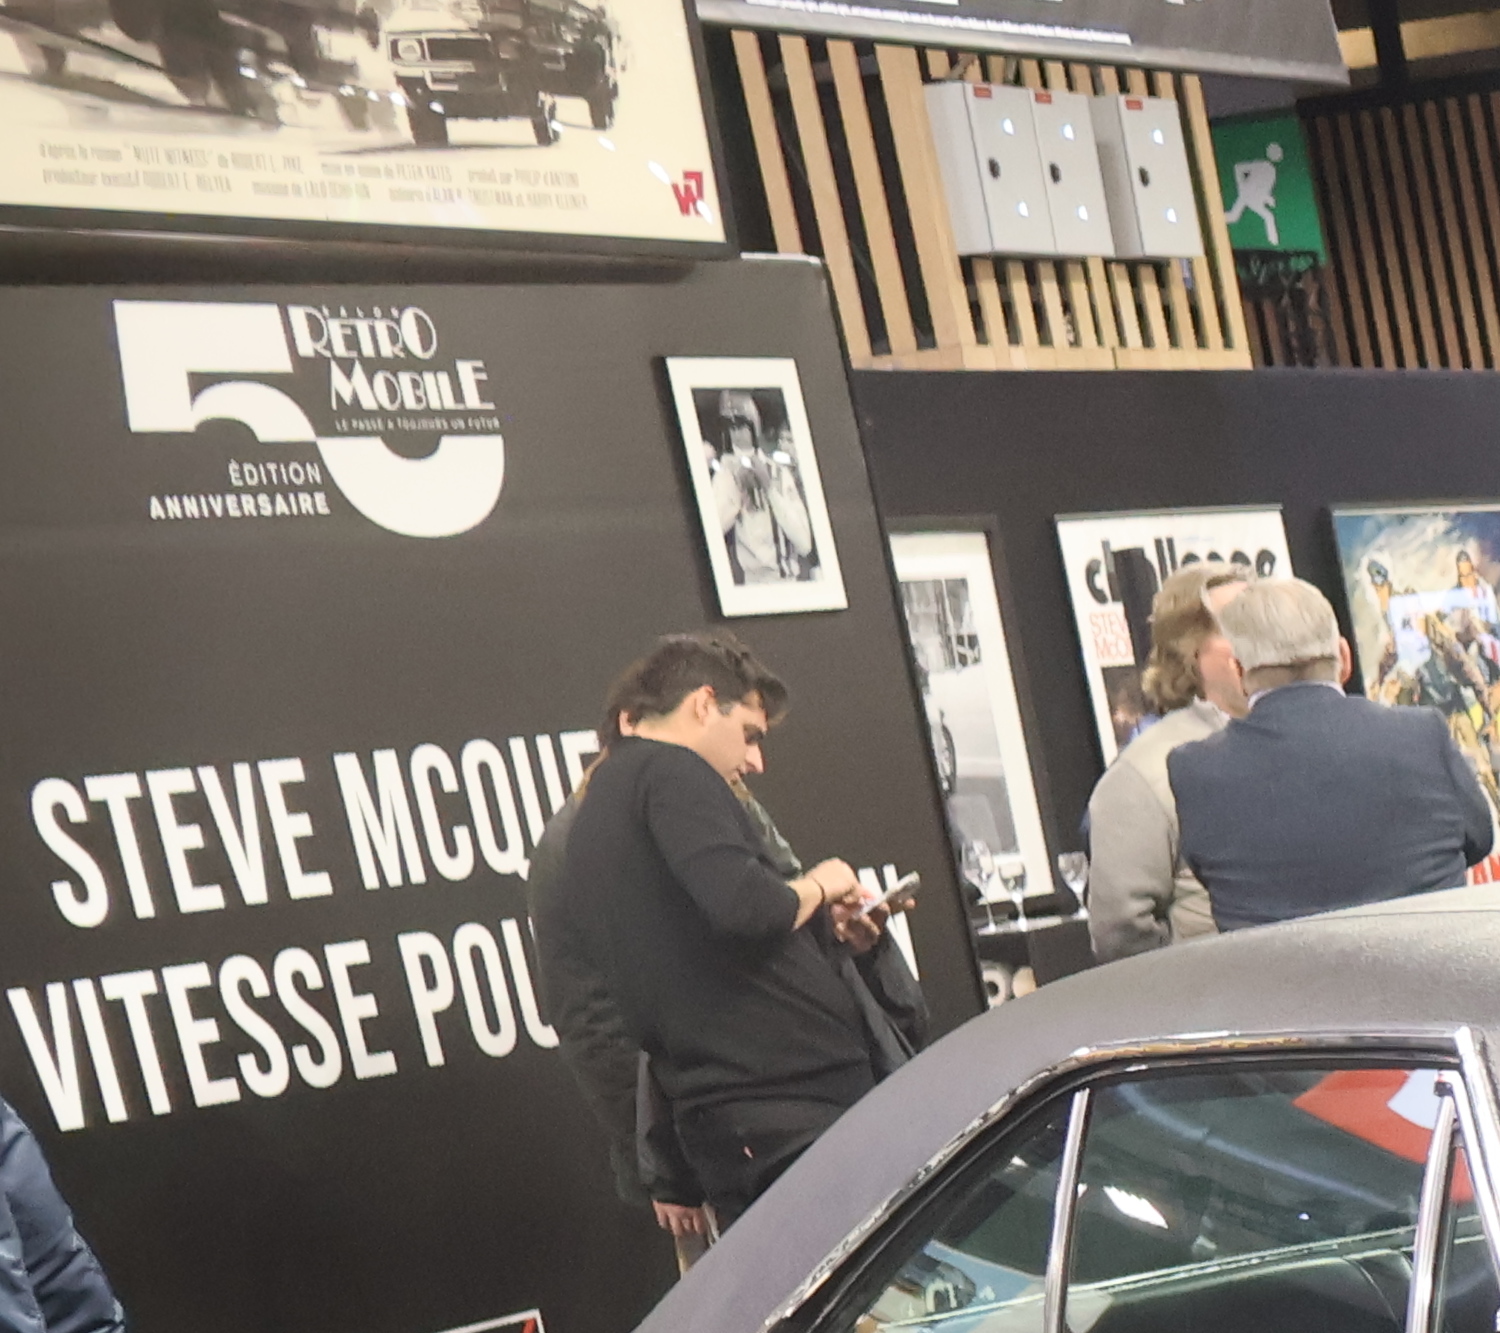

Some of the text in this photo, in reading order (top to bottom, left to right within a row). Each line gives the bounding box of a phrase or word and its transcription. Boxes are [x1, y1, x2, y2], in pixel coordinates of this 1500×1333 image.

[331, 358, 496, 411] MOBILE
[228, 459, 322, 486] ÉDITION
[149, 491, 331, 520] ANNIVERSAIRE
[30, 729, 601, 928] STEVE MCQU
[6, 916, 560, 1132] VITESSE POU
